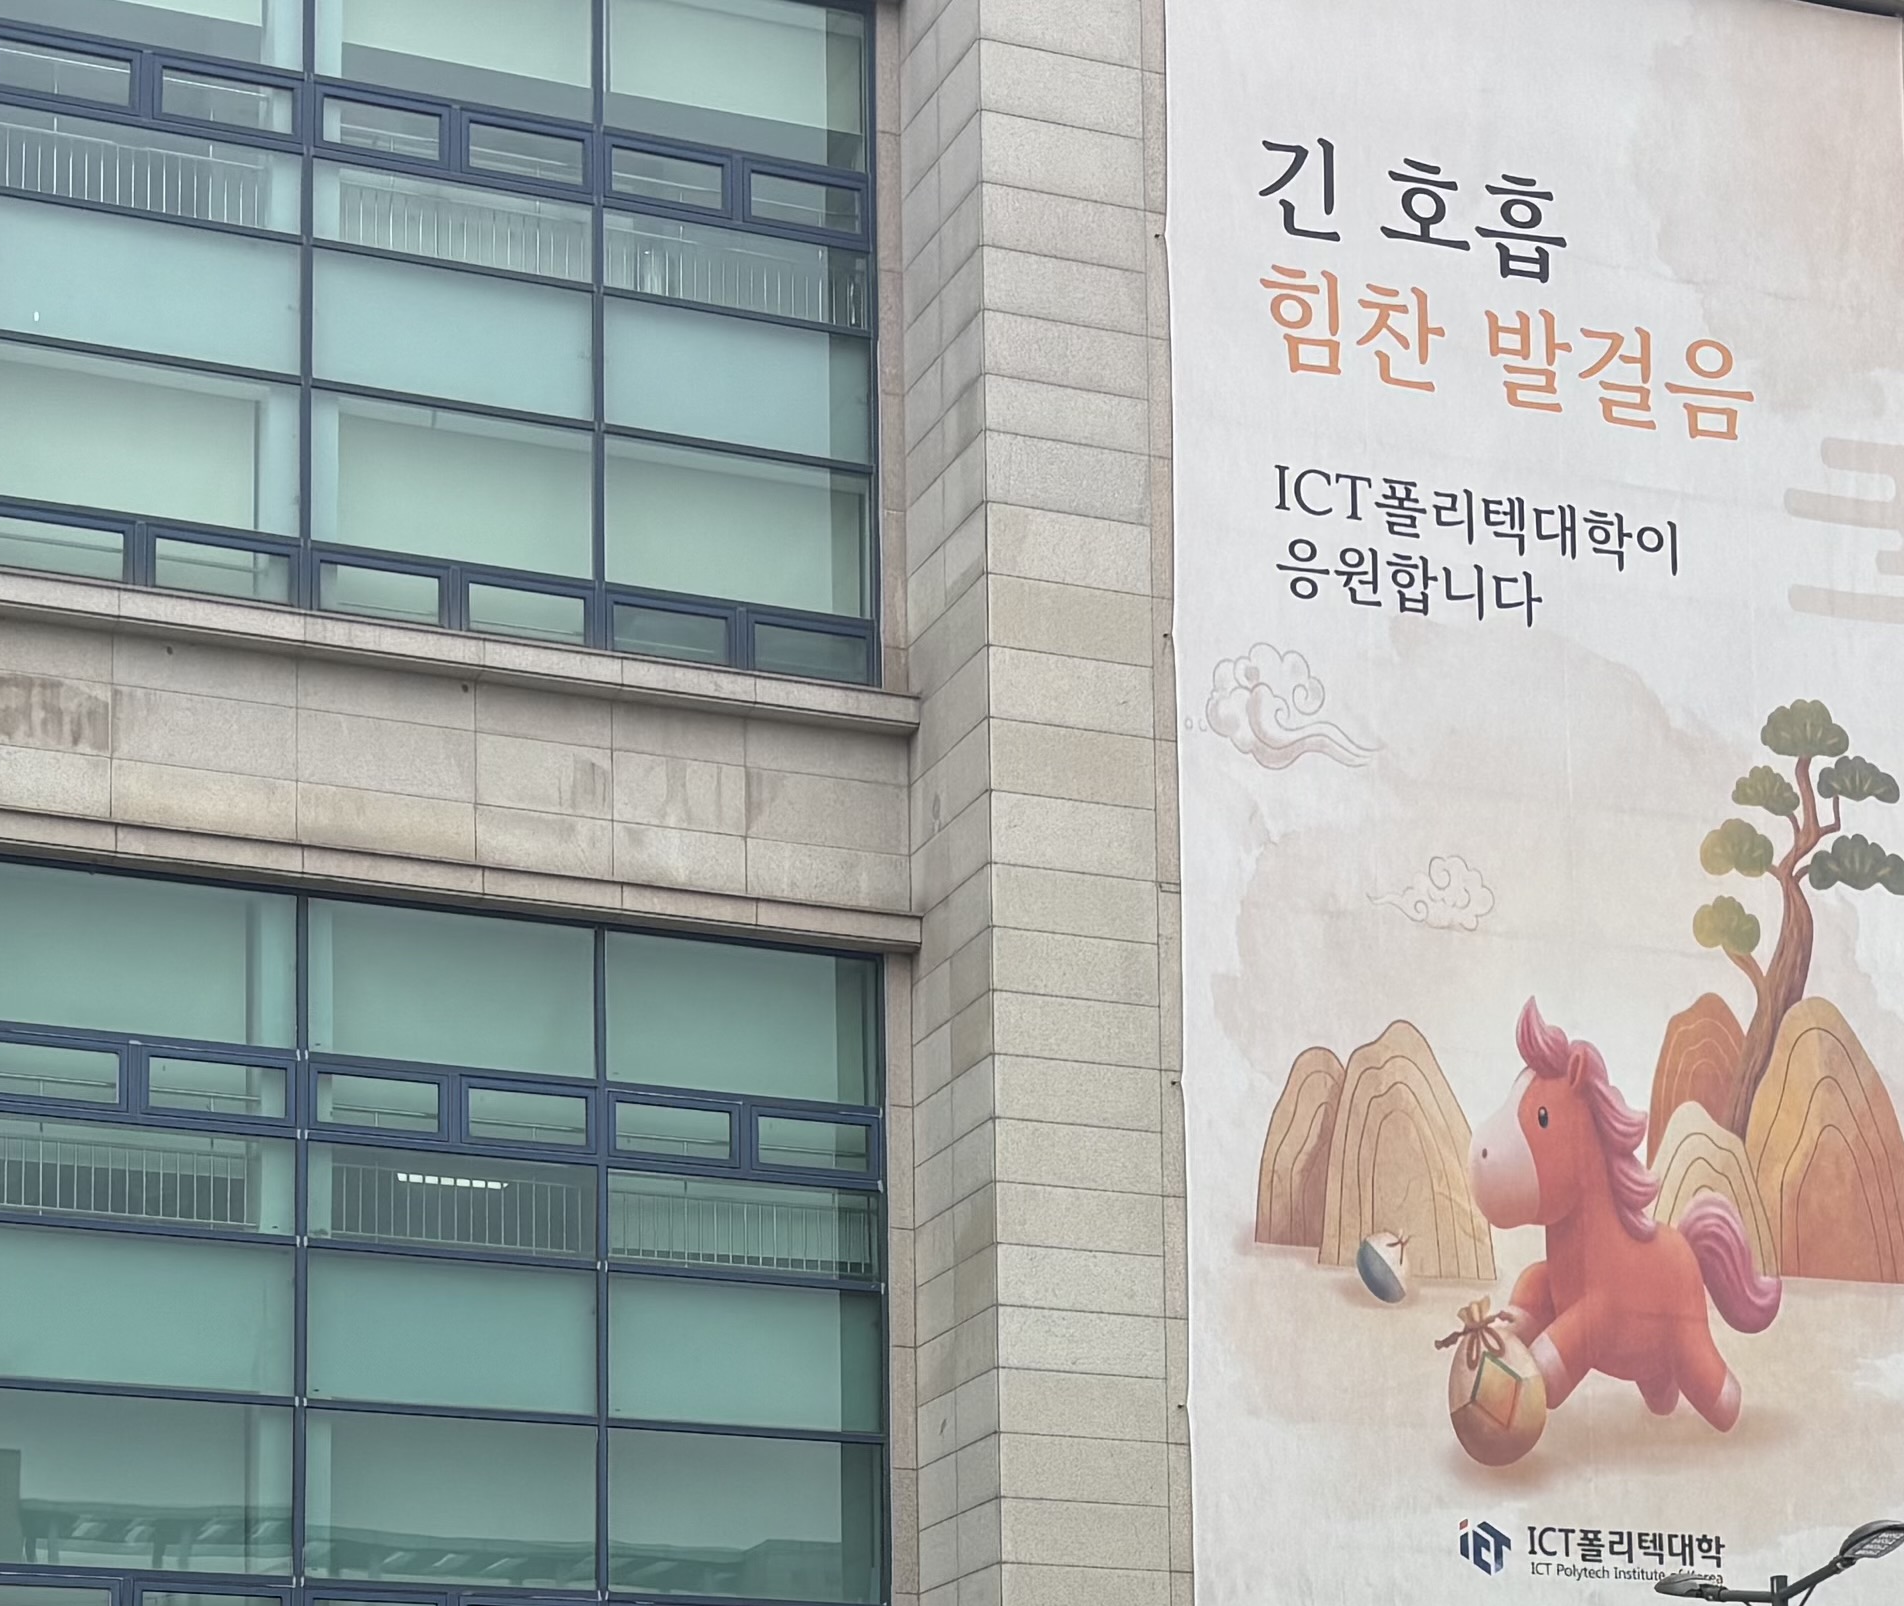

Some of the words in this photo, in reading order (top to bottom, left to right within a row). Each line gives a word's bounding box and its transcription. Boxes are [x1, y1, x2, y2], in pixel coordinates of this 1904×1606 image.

[1258, 137, 1341, 242] 긴
[1379, 157, 1567, 284] 호흡
[1259, 263, 1445, 392] 힘찬
[1485, 308, 1755, 441] 발걸음
[1274, 464, 1680, 576] ICT폴리텍대학이
[1276, 535, 1543, 627] 응원합니다
[1527, 1525, 1726, 1568] ICT폴리텍대학
[1530, 1561, 1553, 1576] ICT
[1556, 1563, 1610, 1582] Polytech
[1613, 1567, 1666, 1581] Institute
